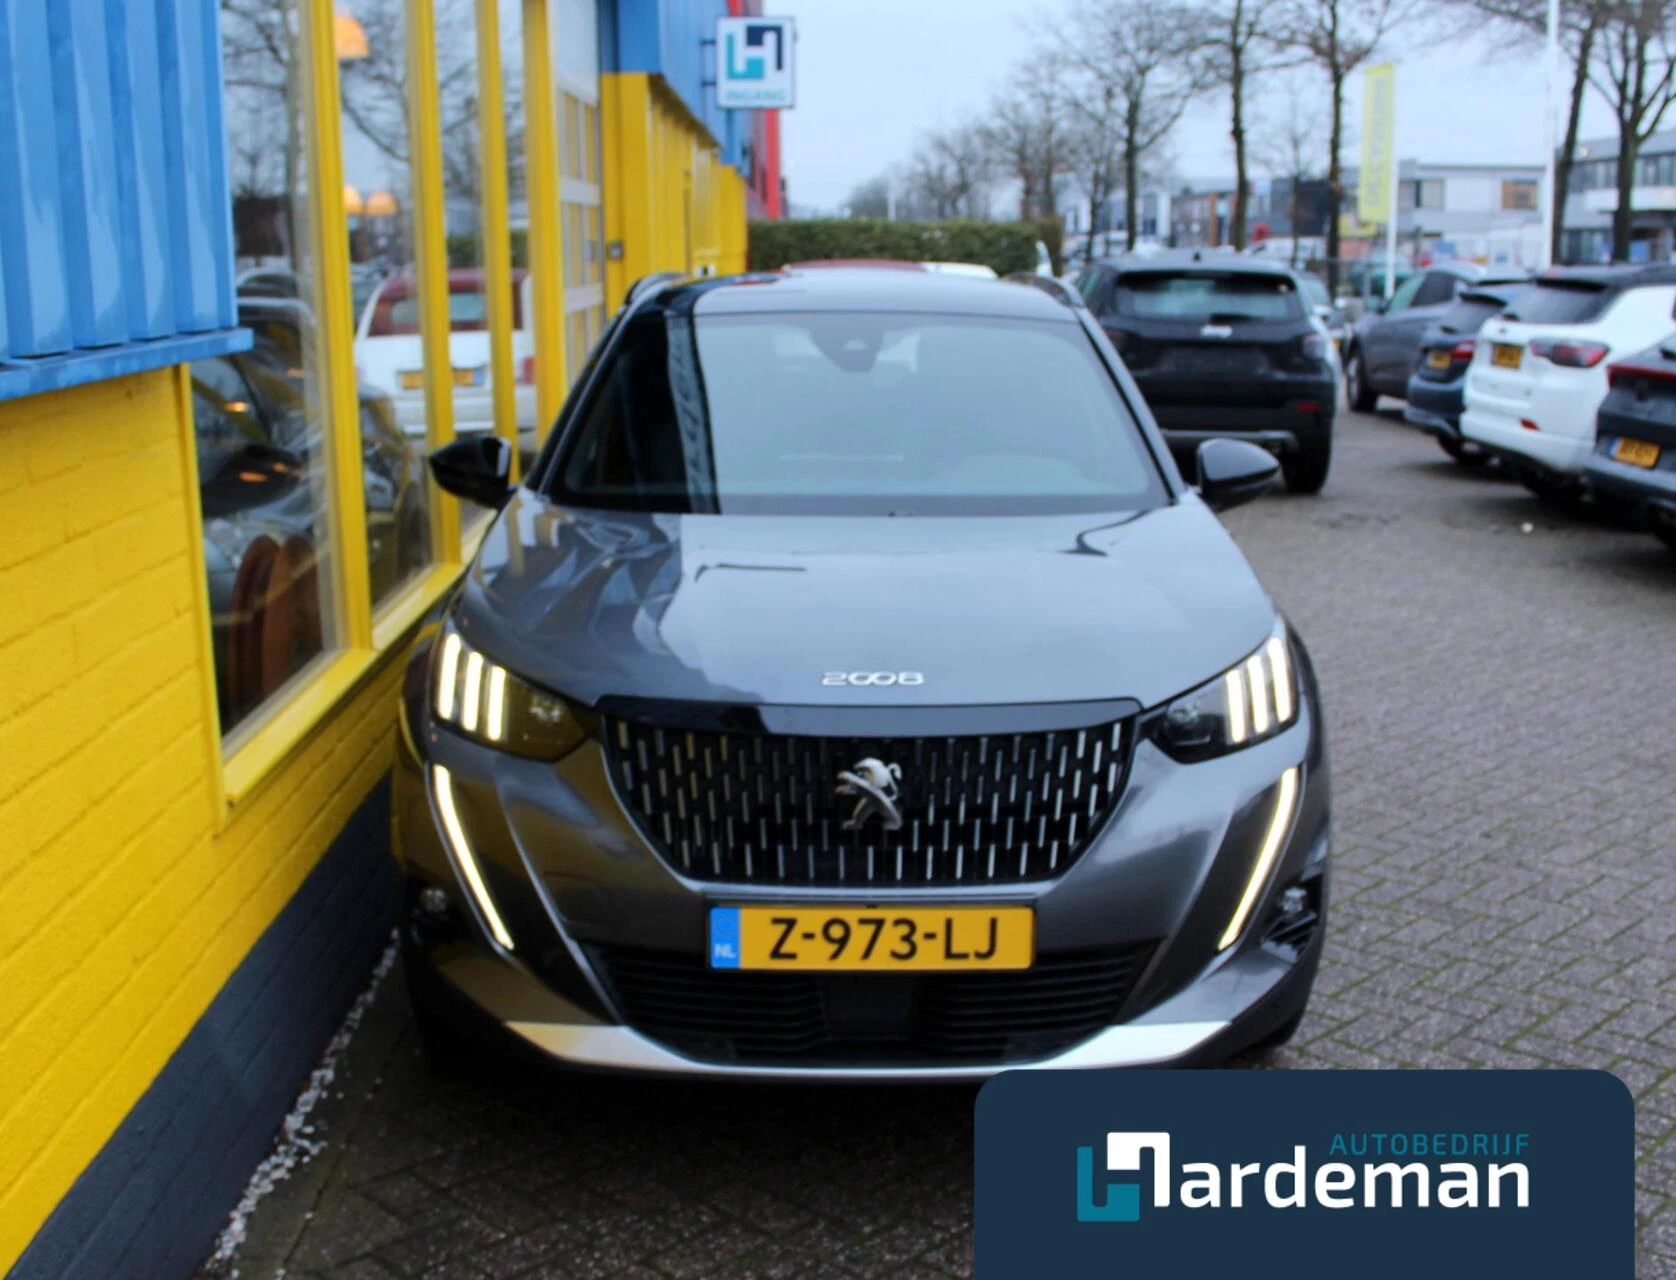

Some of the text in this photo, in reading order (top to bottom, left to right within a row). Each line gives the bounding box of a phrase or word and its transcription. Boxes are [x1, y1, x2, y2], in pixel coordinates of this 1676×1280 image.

[822, 671, 925, 686] 2008
[769, 917, 998, 961] Z-973-LJ
[714, 943, 737, 959] NL
